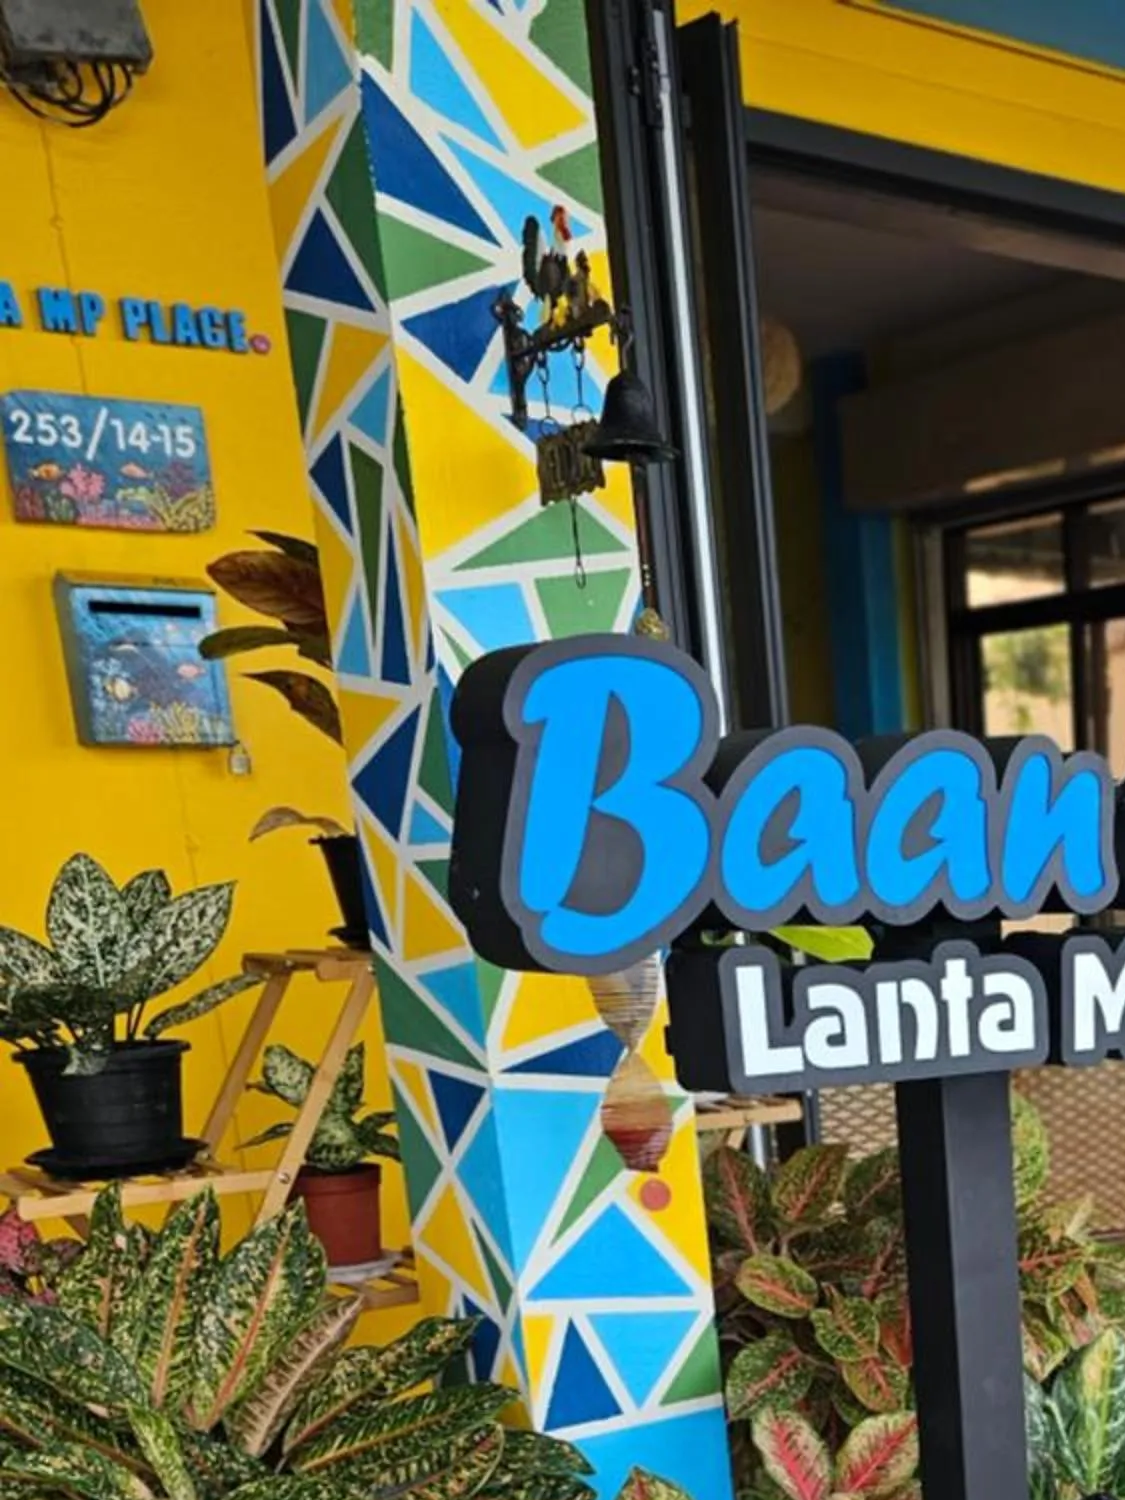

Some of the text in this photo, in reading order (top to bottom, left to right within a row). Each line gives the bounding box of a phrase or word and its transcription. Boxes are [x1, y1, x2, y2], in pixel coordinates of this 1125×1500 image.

[37, 287, 105, 336] MP
[120, 298, 249, 354] PLACE
[9, 406, 197, 460] 253/14-15
[514, 654, 1110, 958] Baan
[734, 957, 1036, 1077] Lanta
